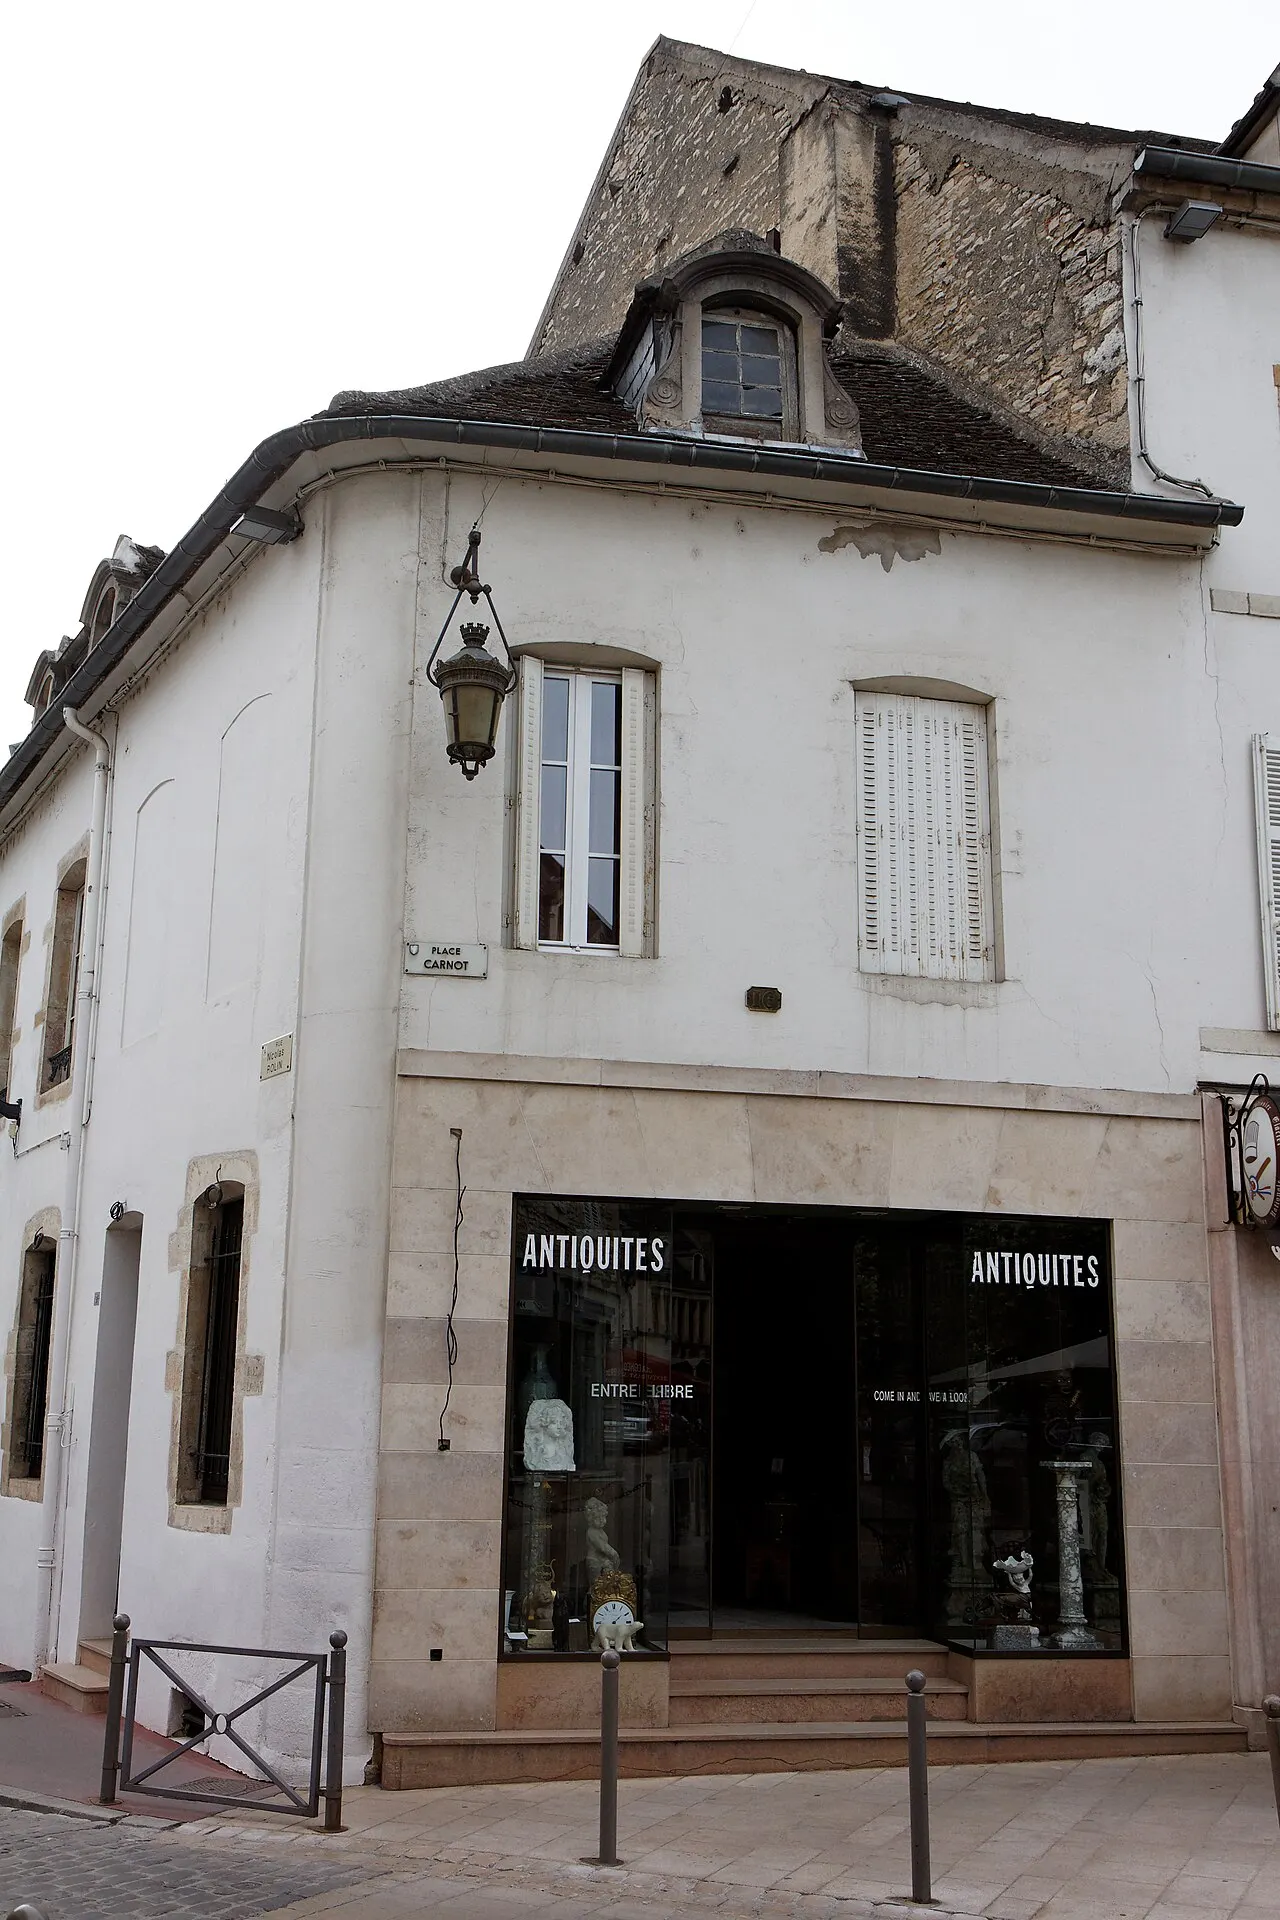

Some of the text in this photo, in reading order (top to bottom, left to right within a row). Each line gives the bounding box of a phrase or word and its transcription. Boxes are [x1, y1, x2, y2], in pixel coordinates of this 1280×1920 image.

[431, 946, 461, 956] PLACE
[423, 959, 469, 971] CARNOT
[266, 1048, 285, 1062] Nicolas
[266, 1060, 283, 1074] ROLIN
[522, 1233, 664, 1273] ANTIQUITES
[971, 1251, 1099, 1289] ANTIQUITES
[590, 1383, 641, 1398] ENTRE
[873, 1390, 895, 1402] COME
[896, 1391, 905, 1402] IN
[942, 1392, 948, 1403] A
